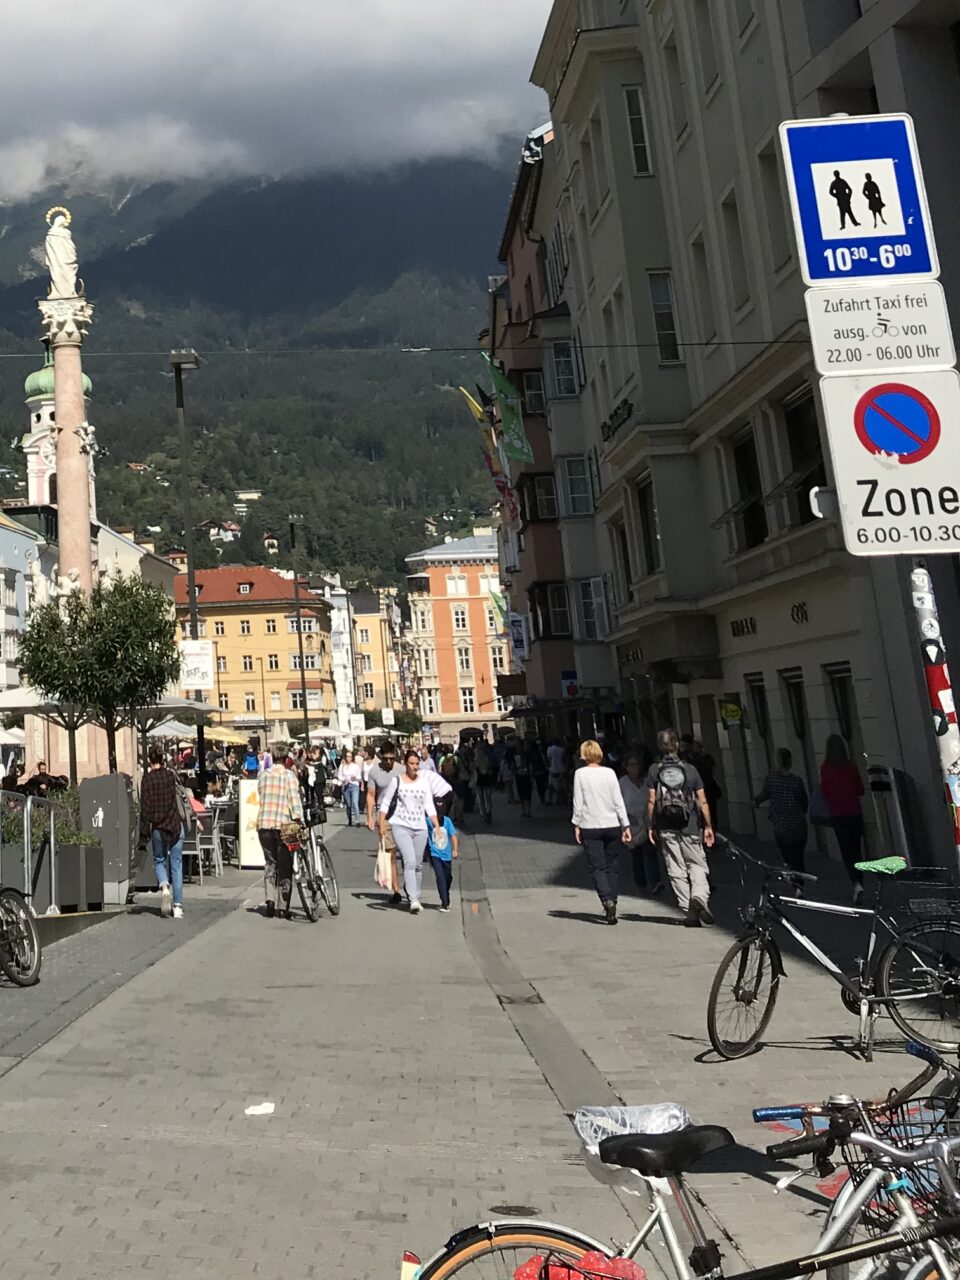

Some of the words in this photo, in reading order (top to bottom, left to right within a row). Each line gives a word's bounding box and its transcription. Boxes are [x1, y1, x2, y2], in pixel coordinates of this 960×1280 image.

[823, 298, 872, 313] Zufahrt
[874, 294, 901, 310] Taxi
[904, 293, 928, 308] frei
[833, 327, 869, 341] ausg.
[901, 324, 927, 336] von
[826, 348, 862, 363] 22.00
[876, 345, 912, 360] 06.00
[916, 344, 940, 358] Uhr
[856, 479, 960, 517] Zone
[857, 524, 960, 544] 6.00-10.30
